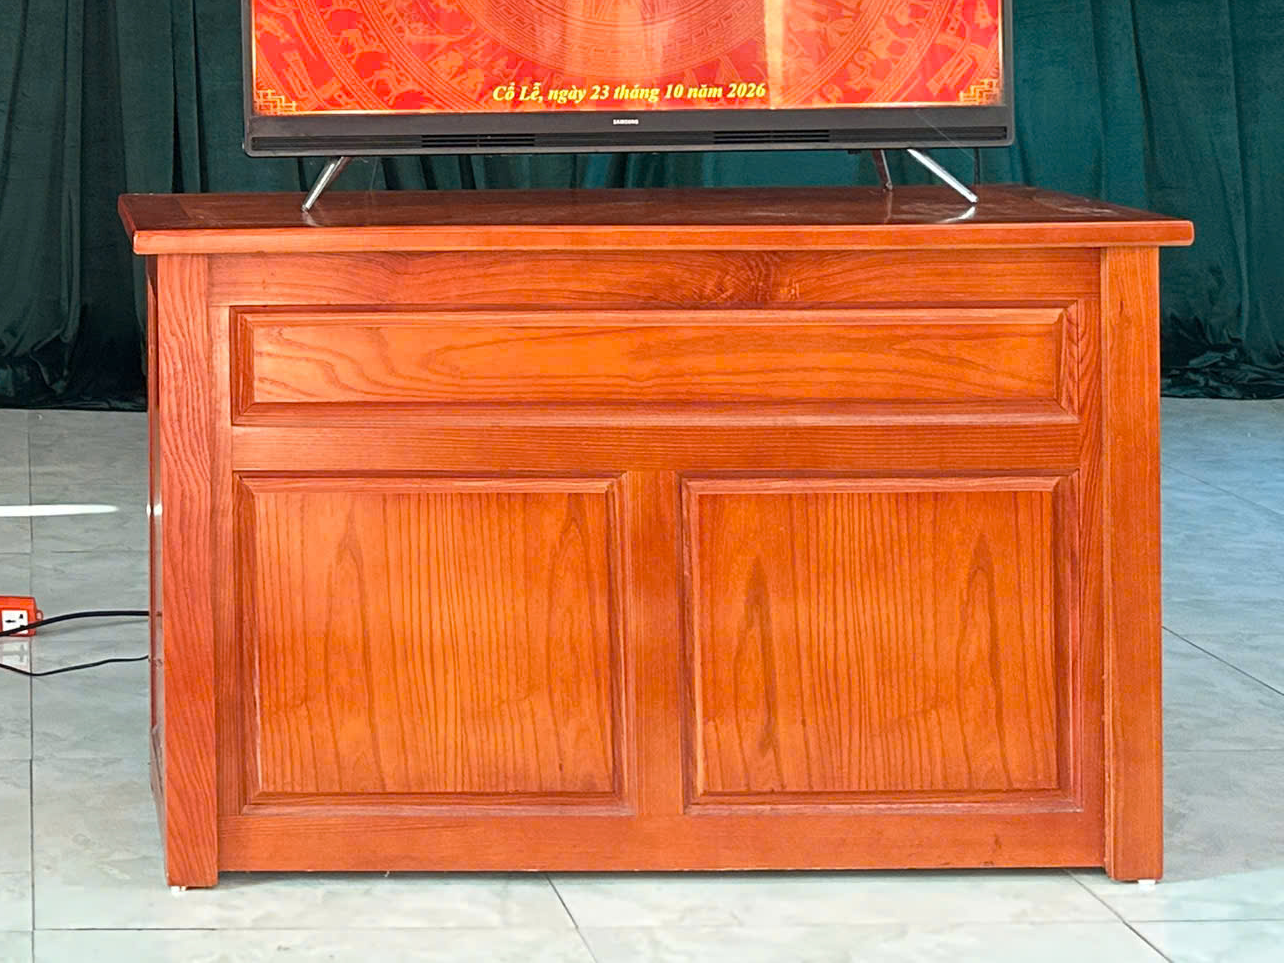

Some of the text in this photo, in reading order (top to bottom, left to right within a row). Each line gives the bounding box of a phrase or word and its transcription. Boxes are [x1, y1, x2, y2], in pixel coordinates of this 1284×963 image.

[547, 85, 587, 104] ngày
[590, 85, 610, 100] 23
[614, 84, 659, 102] tháng
[665, 84, 684, 99] 10
[688, 83, 723, 98] năm
[727, 83, 766, 98] 2026
